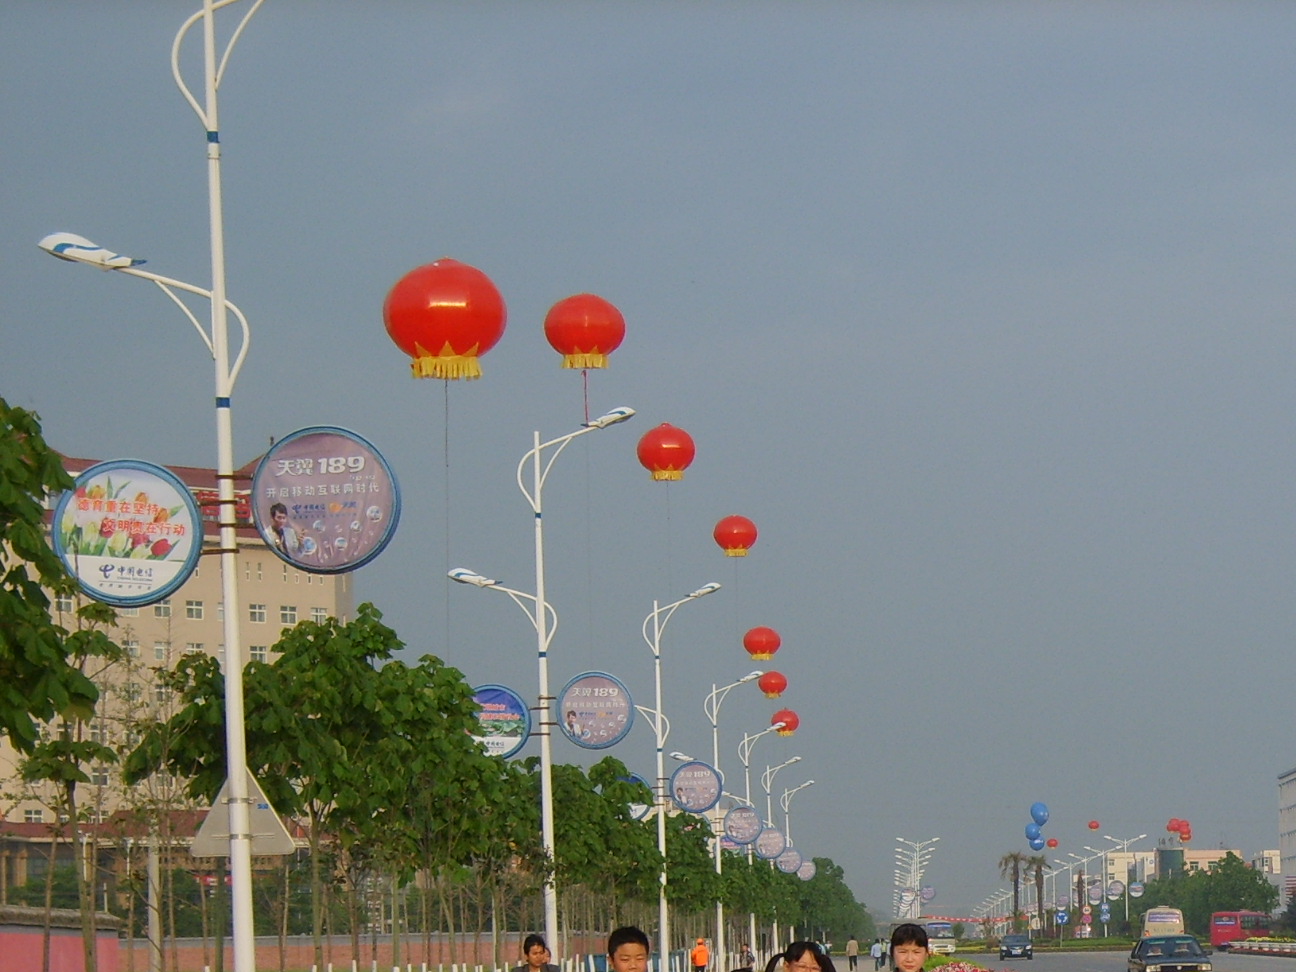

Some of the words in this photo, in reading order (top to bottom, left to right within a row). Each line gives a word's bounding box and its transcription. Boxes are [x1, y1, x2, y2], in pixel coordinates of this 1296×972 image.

[275, 458, 314, 477] 天翼
[318, 456, 365, 474] 189
[593, 687, 619, 697] 189
